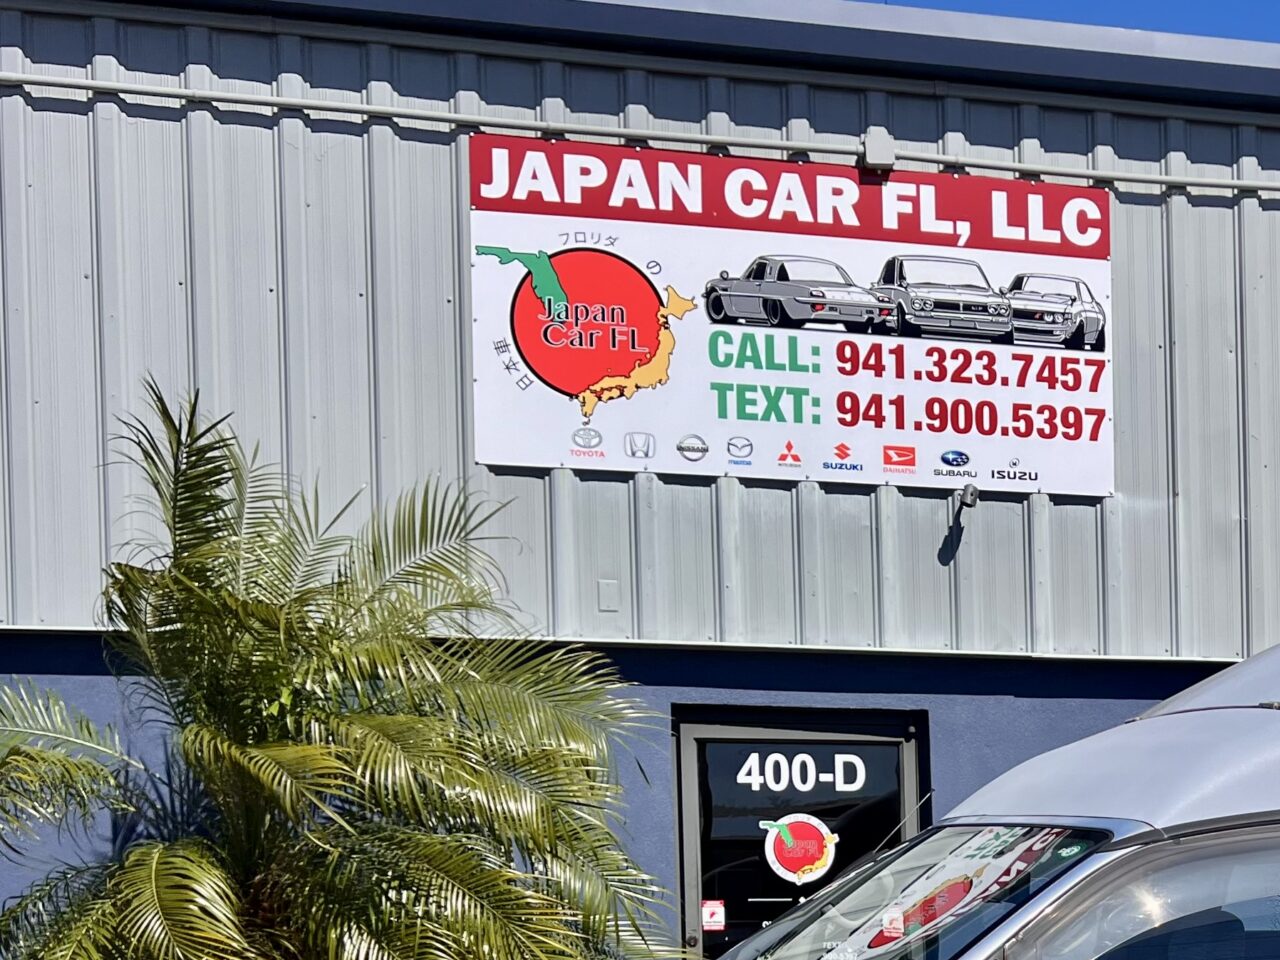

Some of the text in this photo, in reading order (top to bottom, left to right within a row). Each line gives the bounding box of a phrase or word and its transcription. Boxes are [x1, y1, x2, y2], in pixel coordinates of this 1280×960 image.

[480, 147, 1102, 247] JAPAN CAR FL, LLC
[558, 231, 619, 247] フロリダ
[538, 296, 627, 328] Japan
[541, 322, 650, 352] Car FL
[708, 329, 1107, 393] CALL: 941.323.7457
[710, 382, 1107, 442] TEXT: 941.900.5397
[569, 448, 605, 458] TOYOTA
[822, 461, 863, 472] SUZUKI
[933, 468, 978, 478] SUBARU
[991, 469, 1038, 481] ISUZU
[736, 752, 867, 792] 400-D
